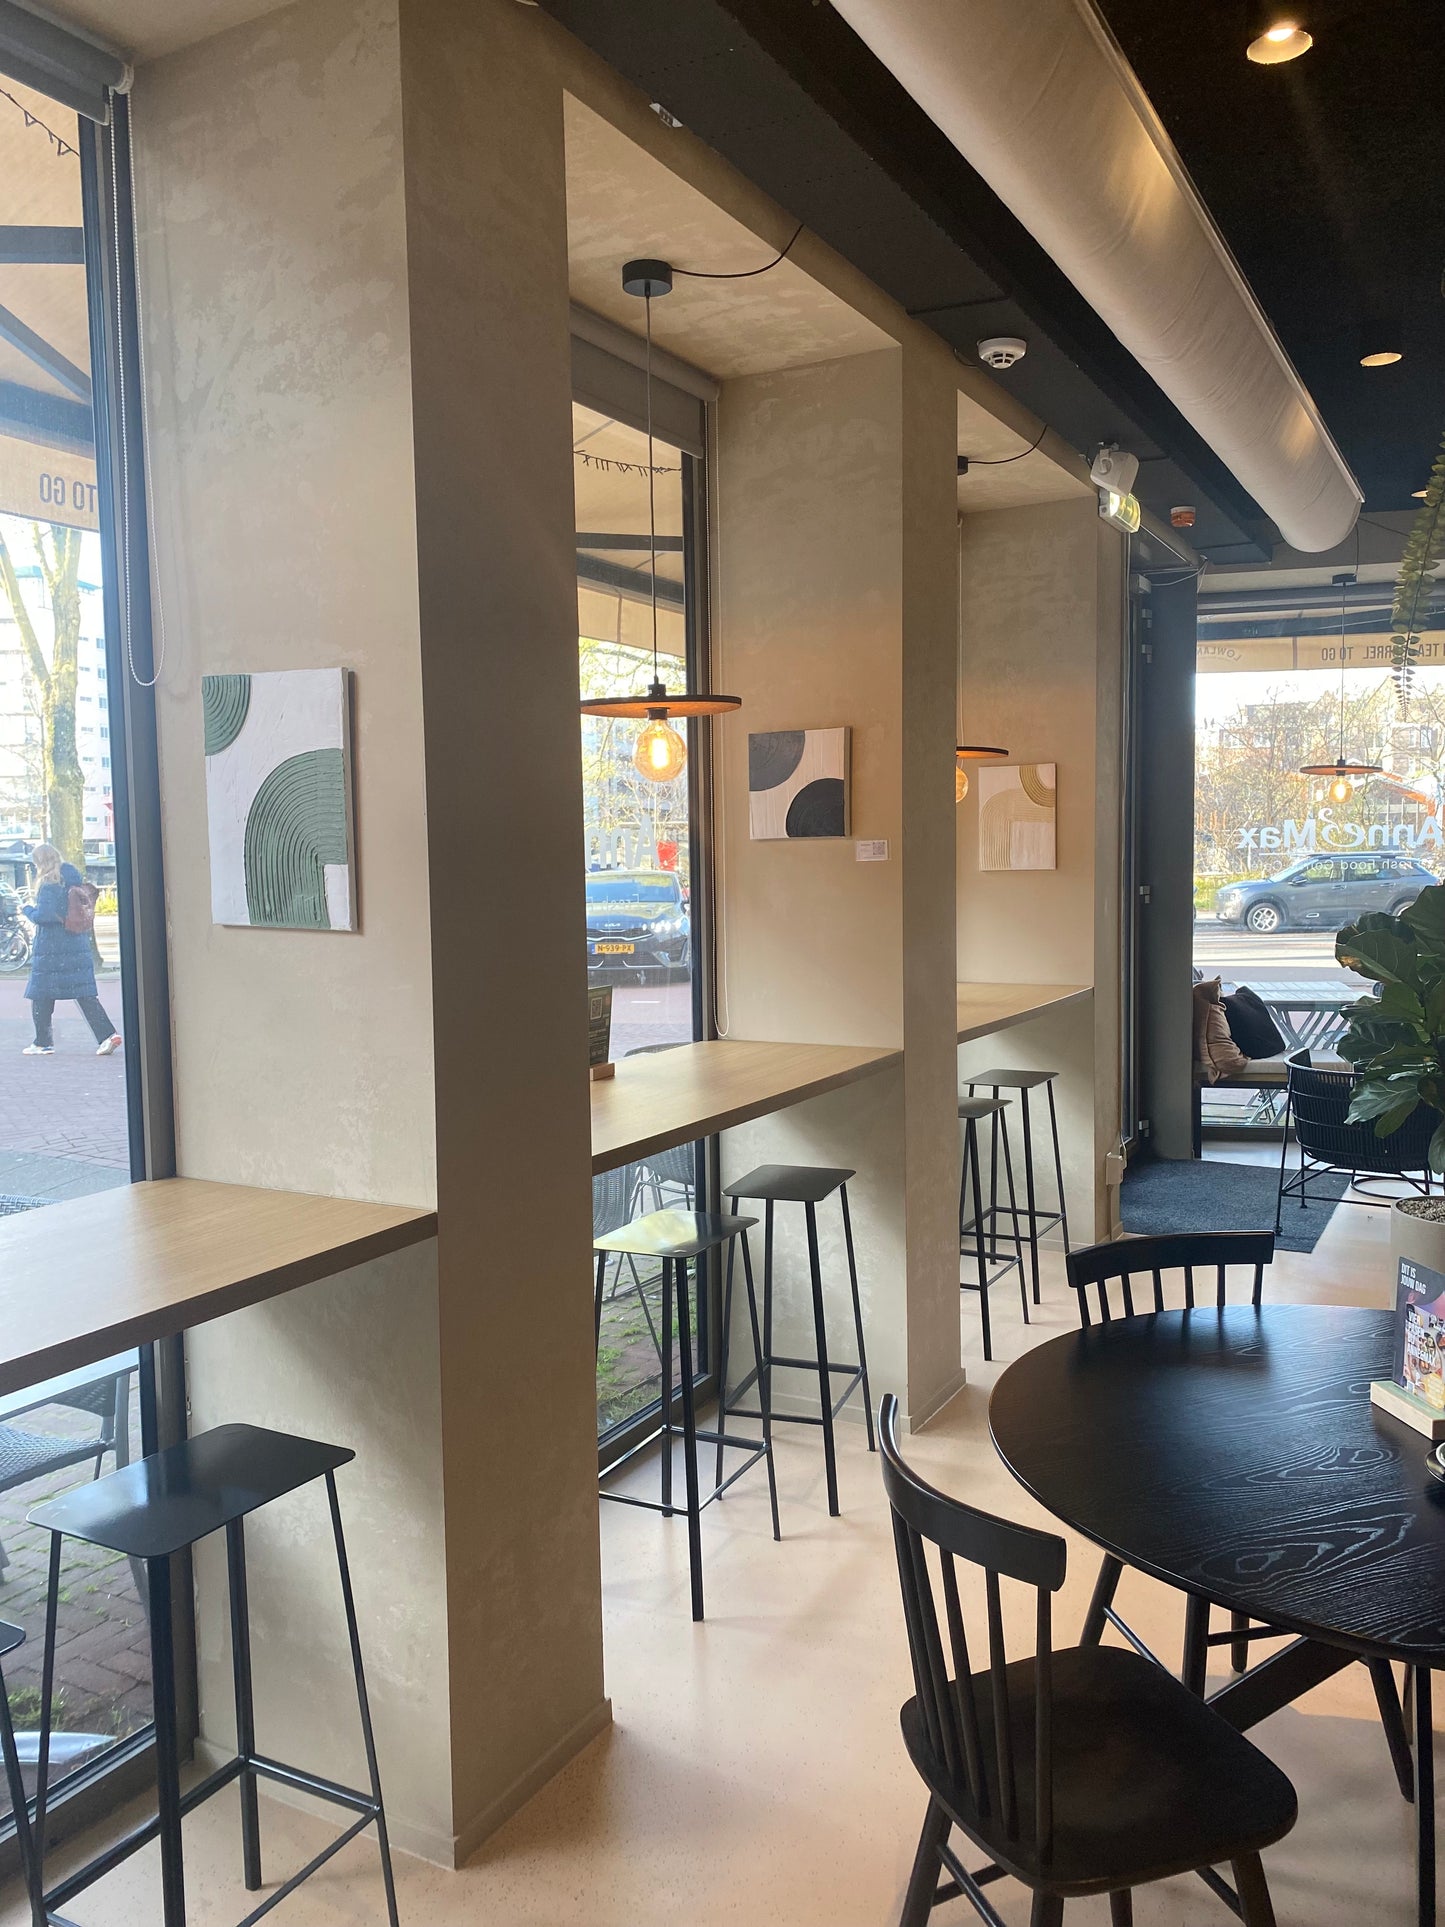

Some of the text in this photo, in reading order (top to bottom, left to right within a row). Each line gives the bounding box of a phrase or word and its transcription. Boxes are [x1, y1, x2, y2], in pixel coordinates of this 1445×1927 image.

[1401, 1262, 1416, 1278] DIT IS
[1415, 1280, 1427, 1295] DAG
